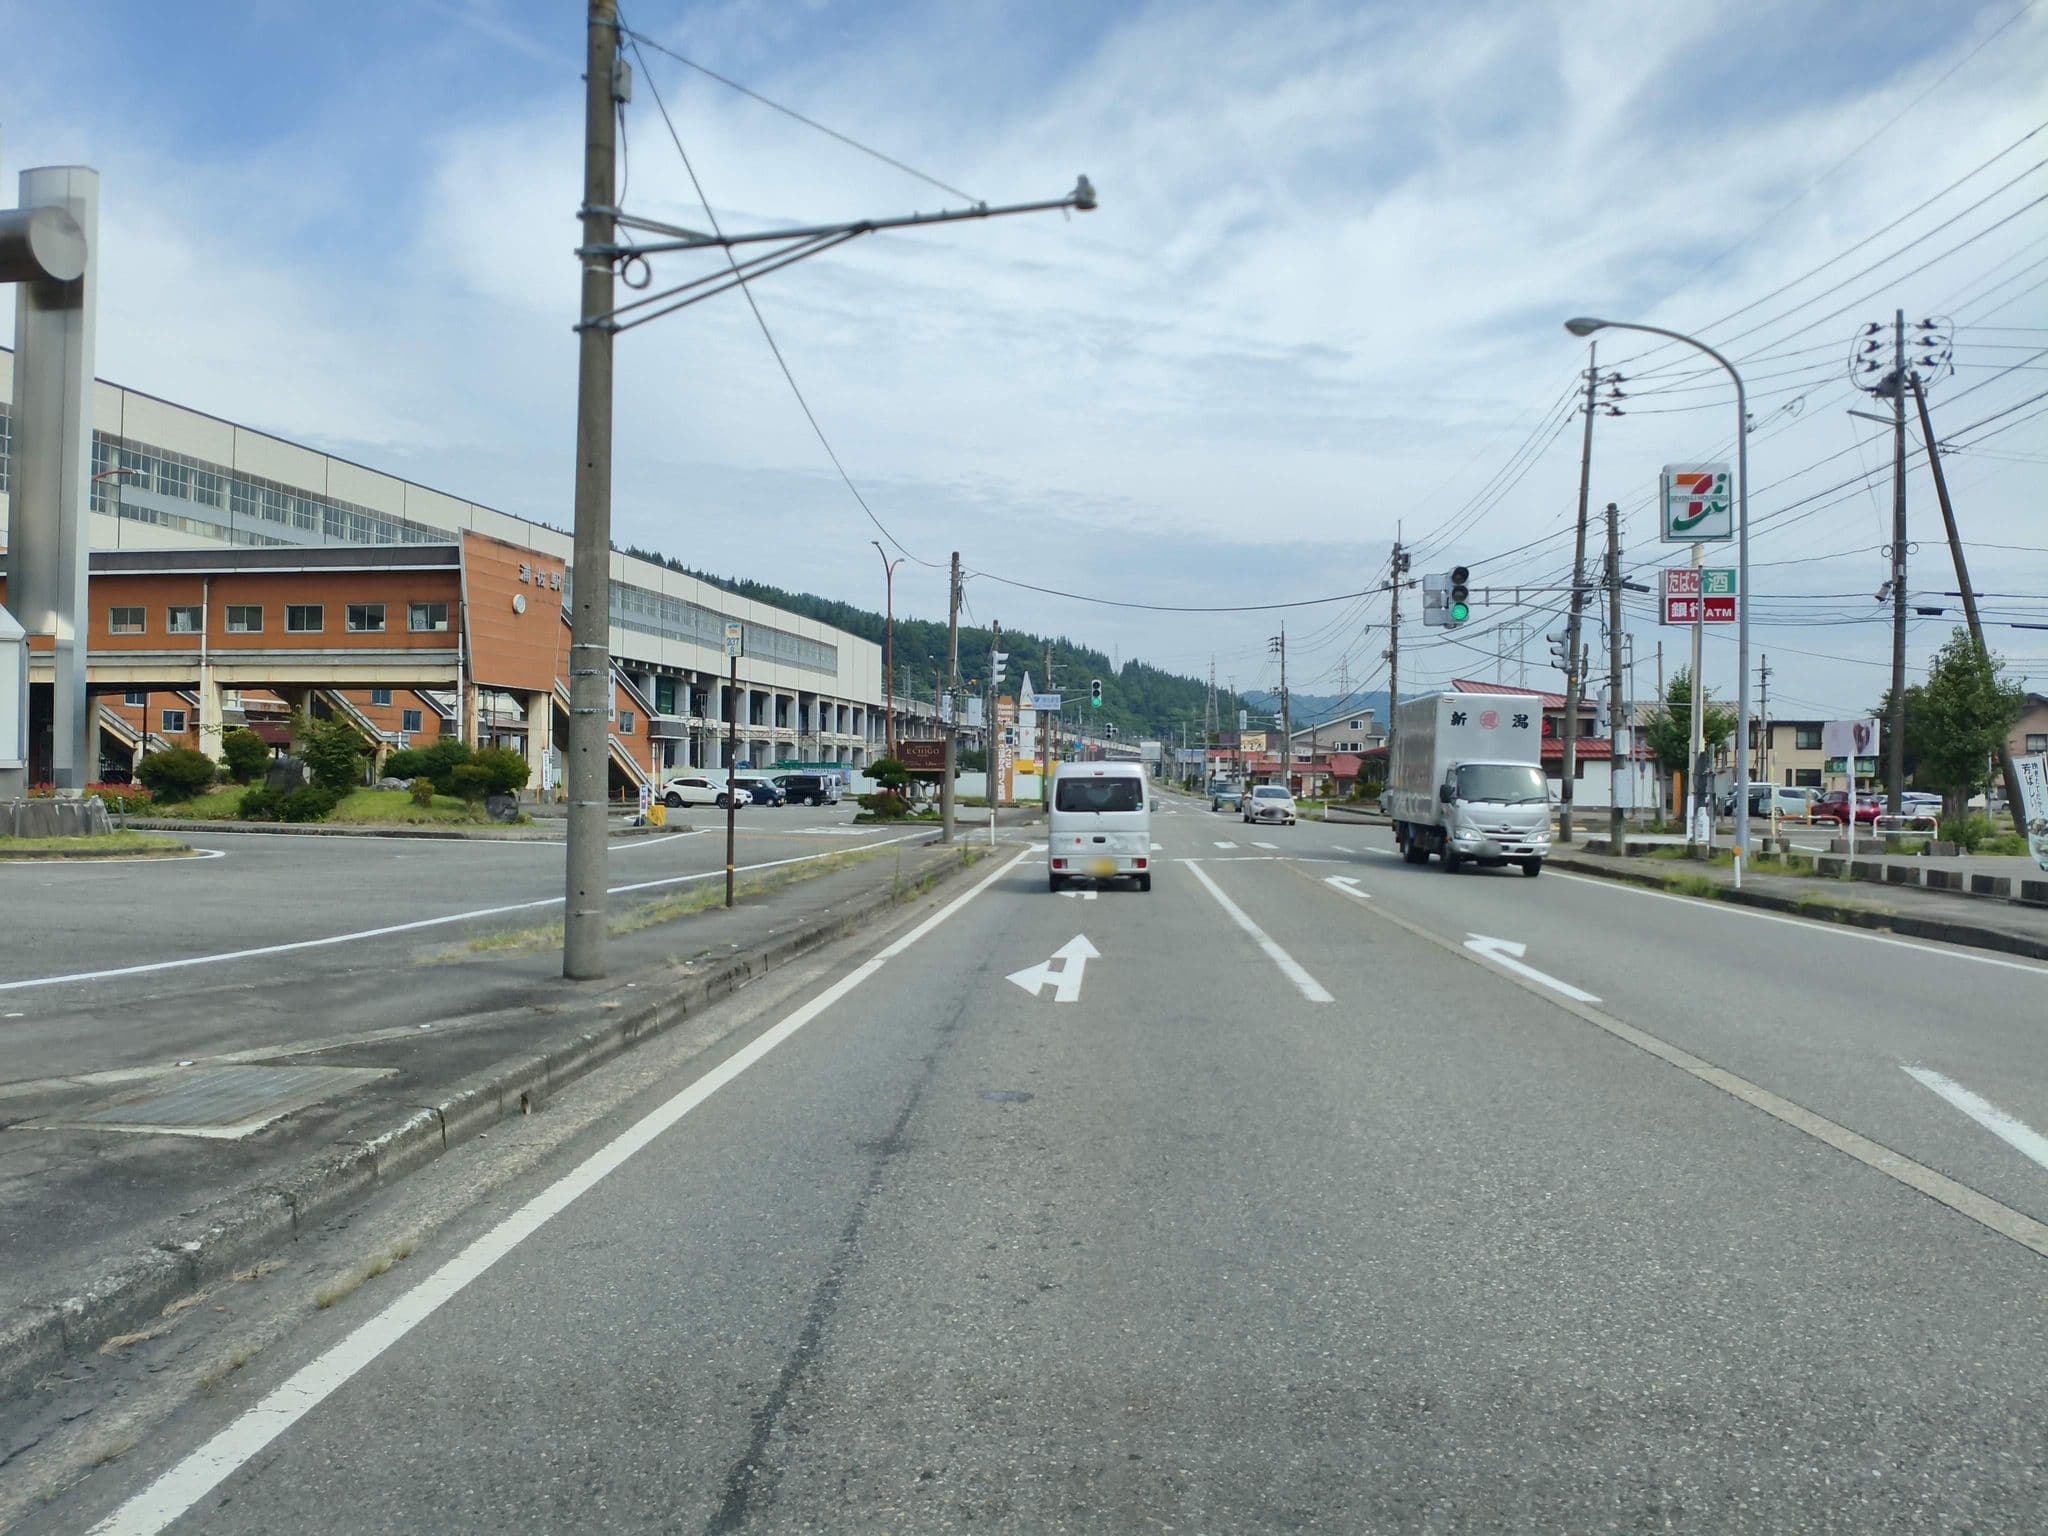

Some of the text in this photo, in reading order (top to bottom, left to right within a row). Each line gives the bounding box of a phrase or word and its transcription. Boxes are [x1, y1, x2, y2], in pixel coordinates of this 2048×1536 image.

[1668, 571, 1700, 593] たばこ
[1706, 571, 1729, 593] 酒
[1706, 608, 1732, 617] ATM
